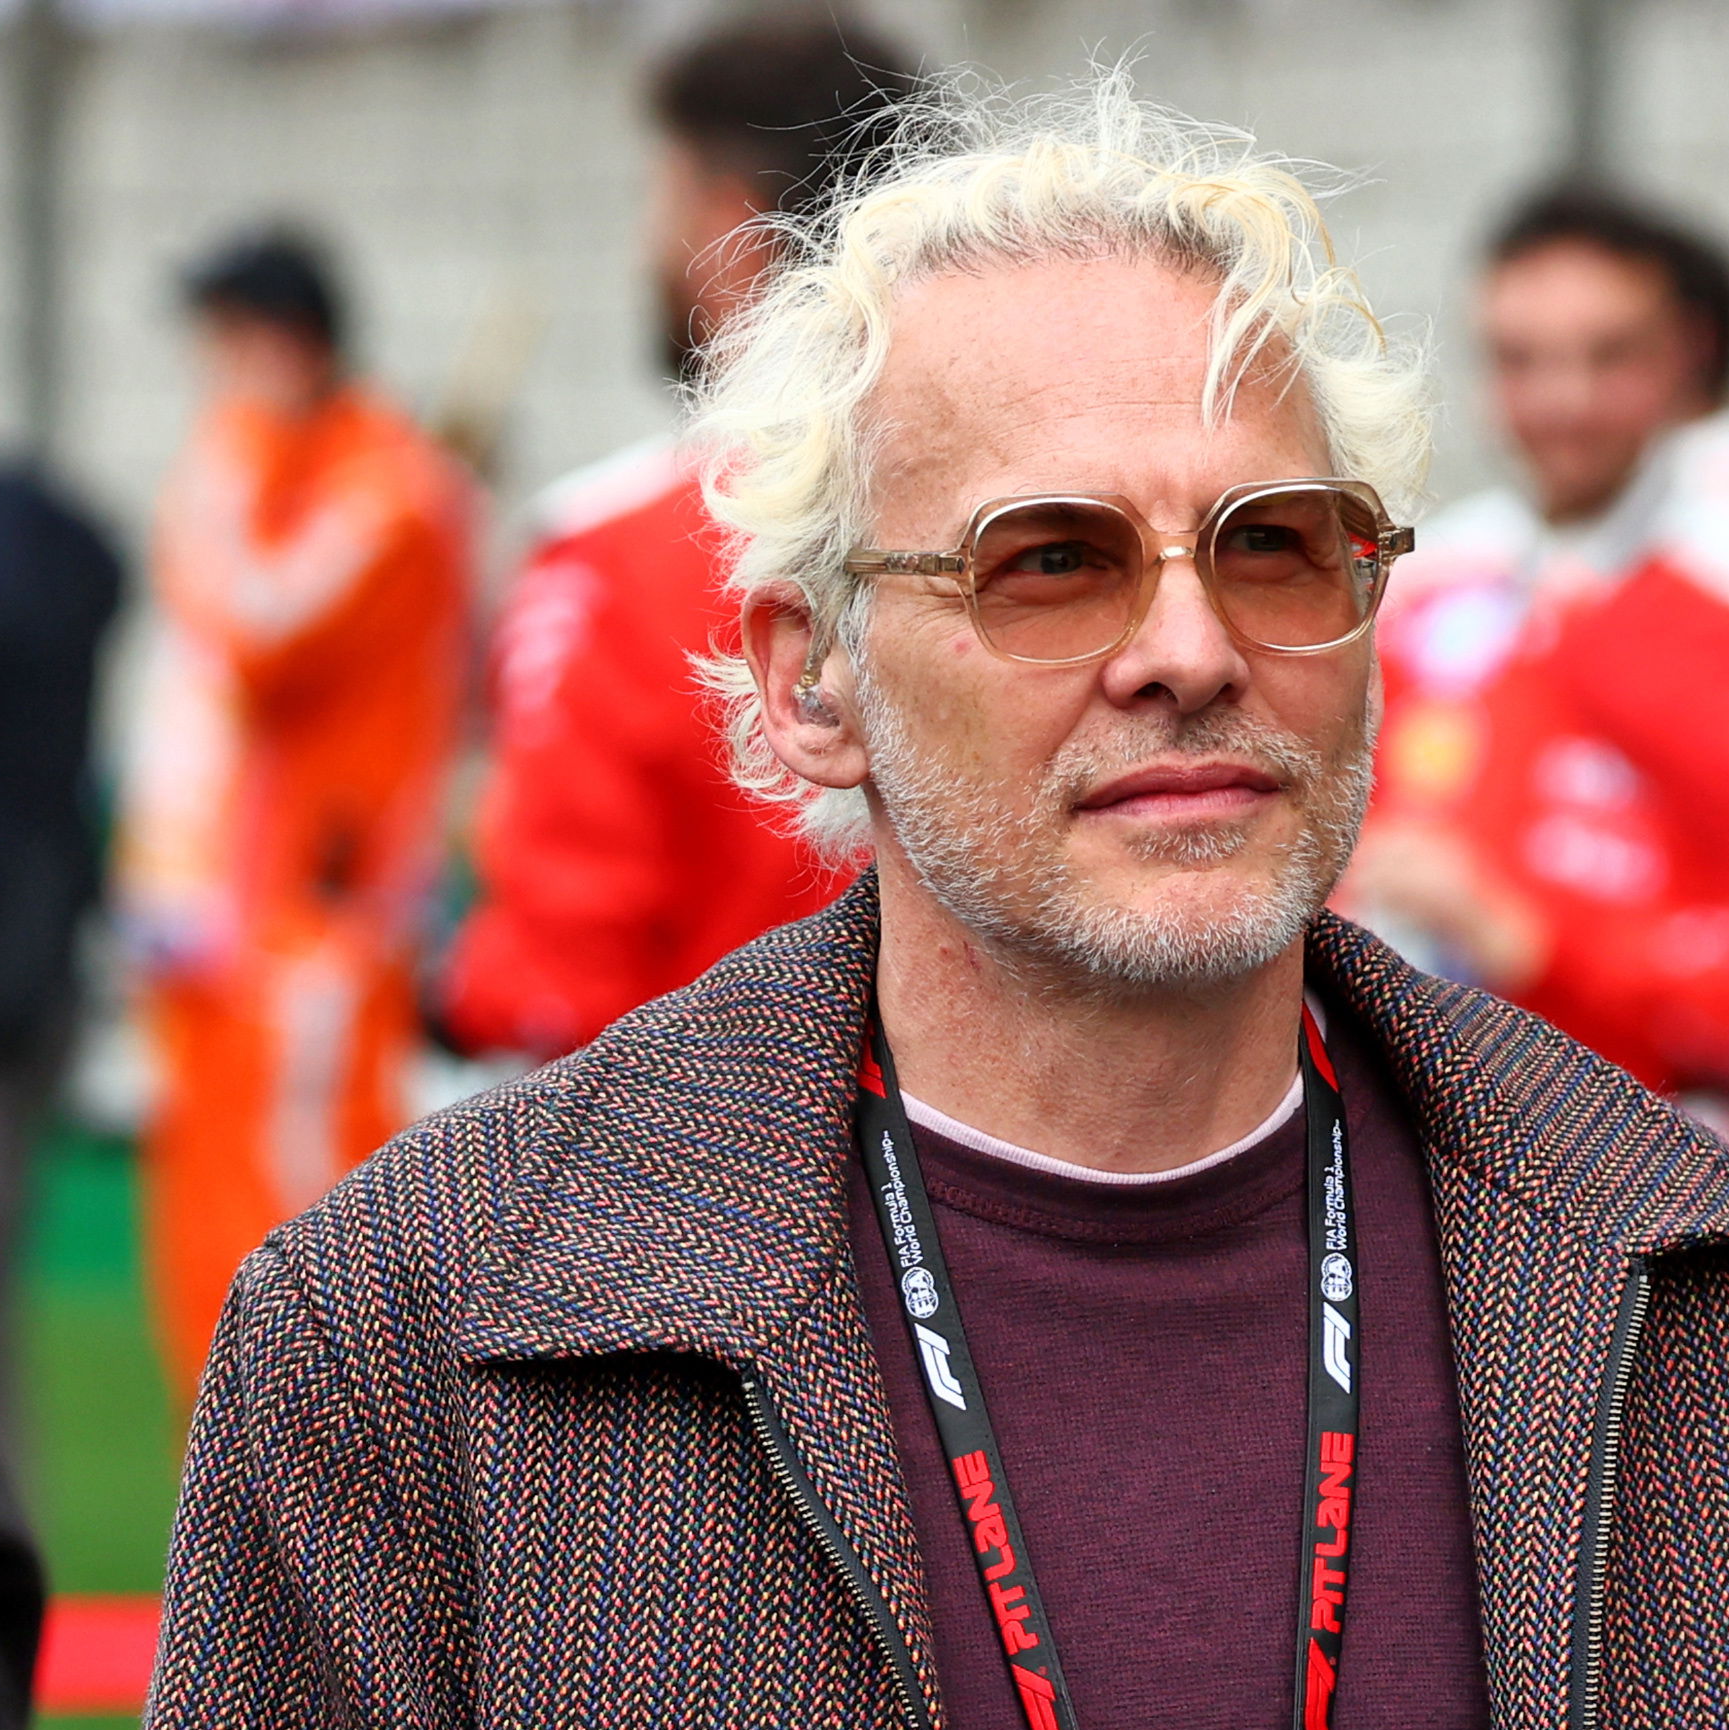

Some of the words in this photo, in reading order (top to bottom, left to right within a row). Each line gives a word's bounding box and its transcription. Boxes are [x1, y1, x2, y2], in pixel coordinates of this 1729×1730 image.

[884, 1192, 907, 1246] Formula
[1324, 1176, 1337, 1227] Formula
[905, 1224, 924, 1265] World
[1326, 1229, 1337, 1250] FIA
[1336, 1211, 1347, 1250] World
[898, 1245, 914, 1268] FIA
[915, 1322, 967, 1411] F1
[1324, 1302, 1351, 1394] F1
